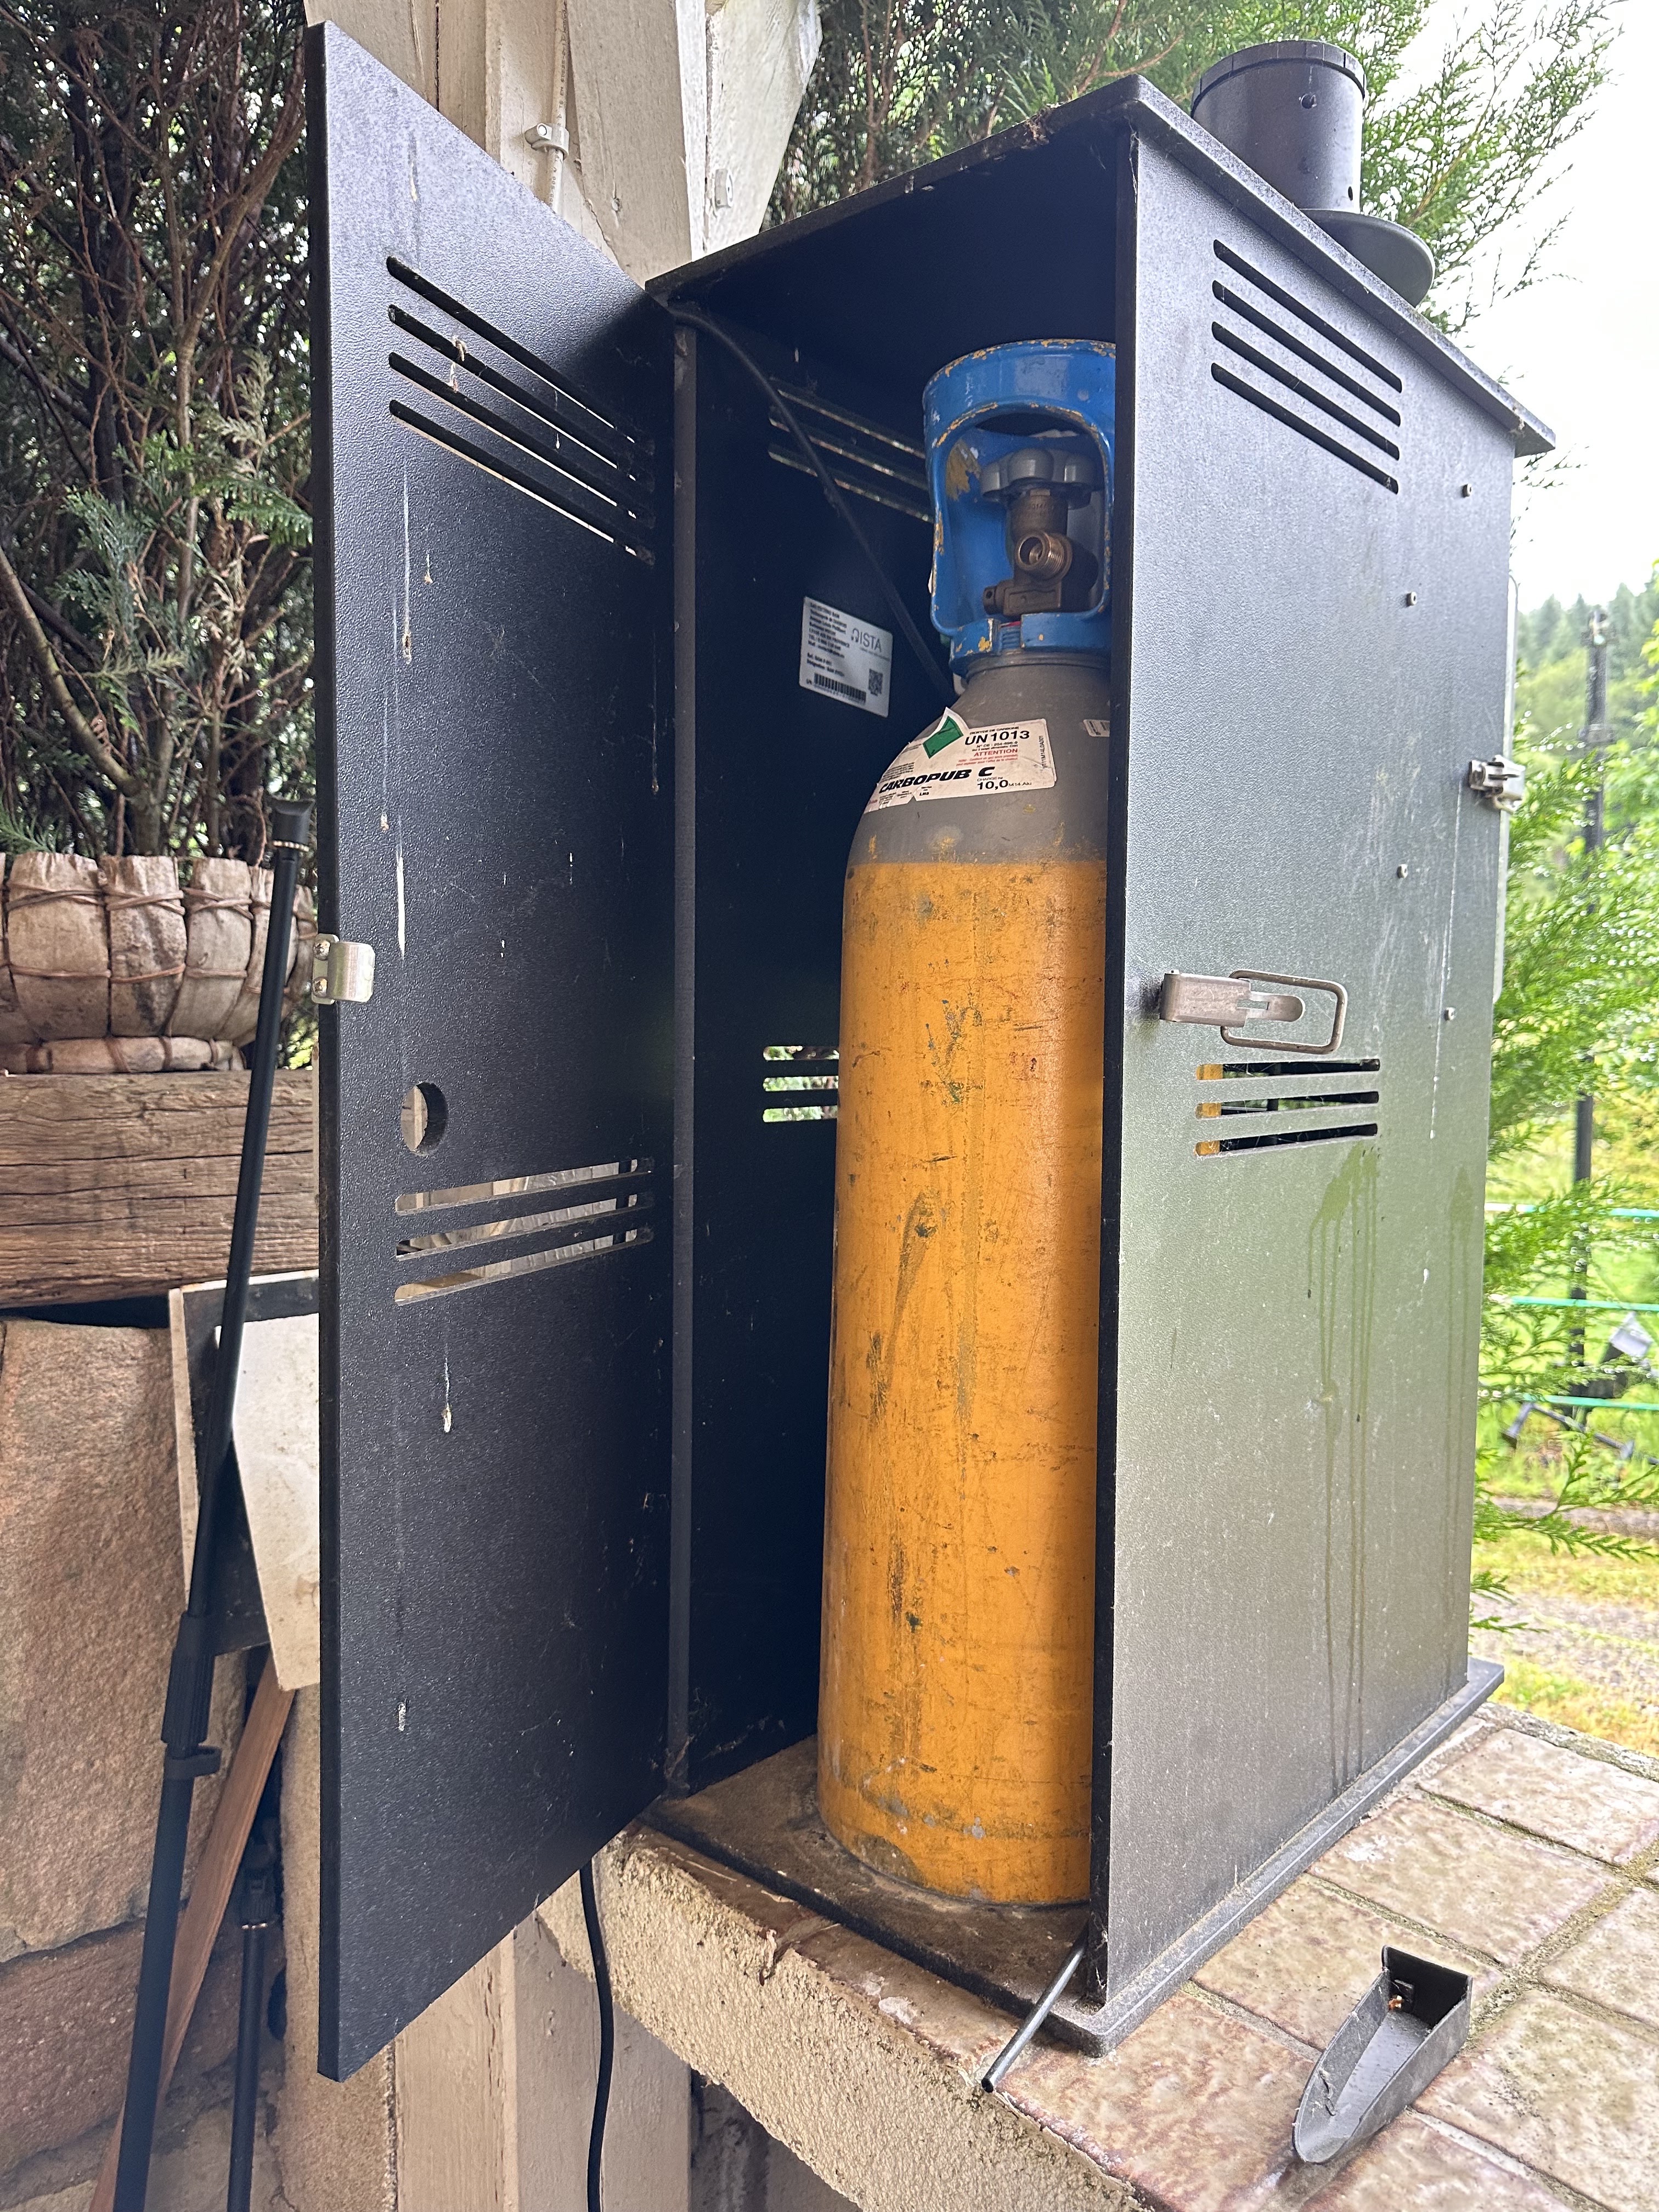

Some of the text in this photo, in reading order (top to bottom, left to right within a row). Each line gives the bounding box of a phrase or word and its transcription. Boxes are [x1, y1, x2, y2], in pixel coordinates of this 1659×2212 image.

[964, 730, 1030, 746] UN 1013
[973, 748, 1018, 757] ATTENTION
[879, 769, 972, 793] CARBOPUB
[978, 766, 995, 776] C
[977, 780, 1008, 790] 10,0
